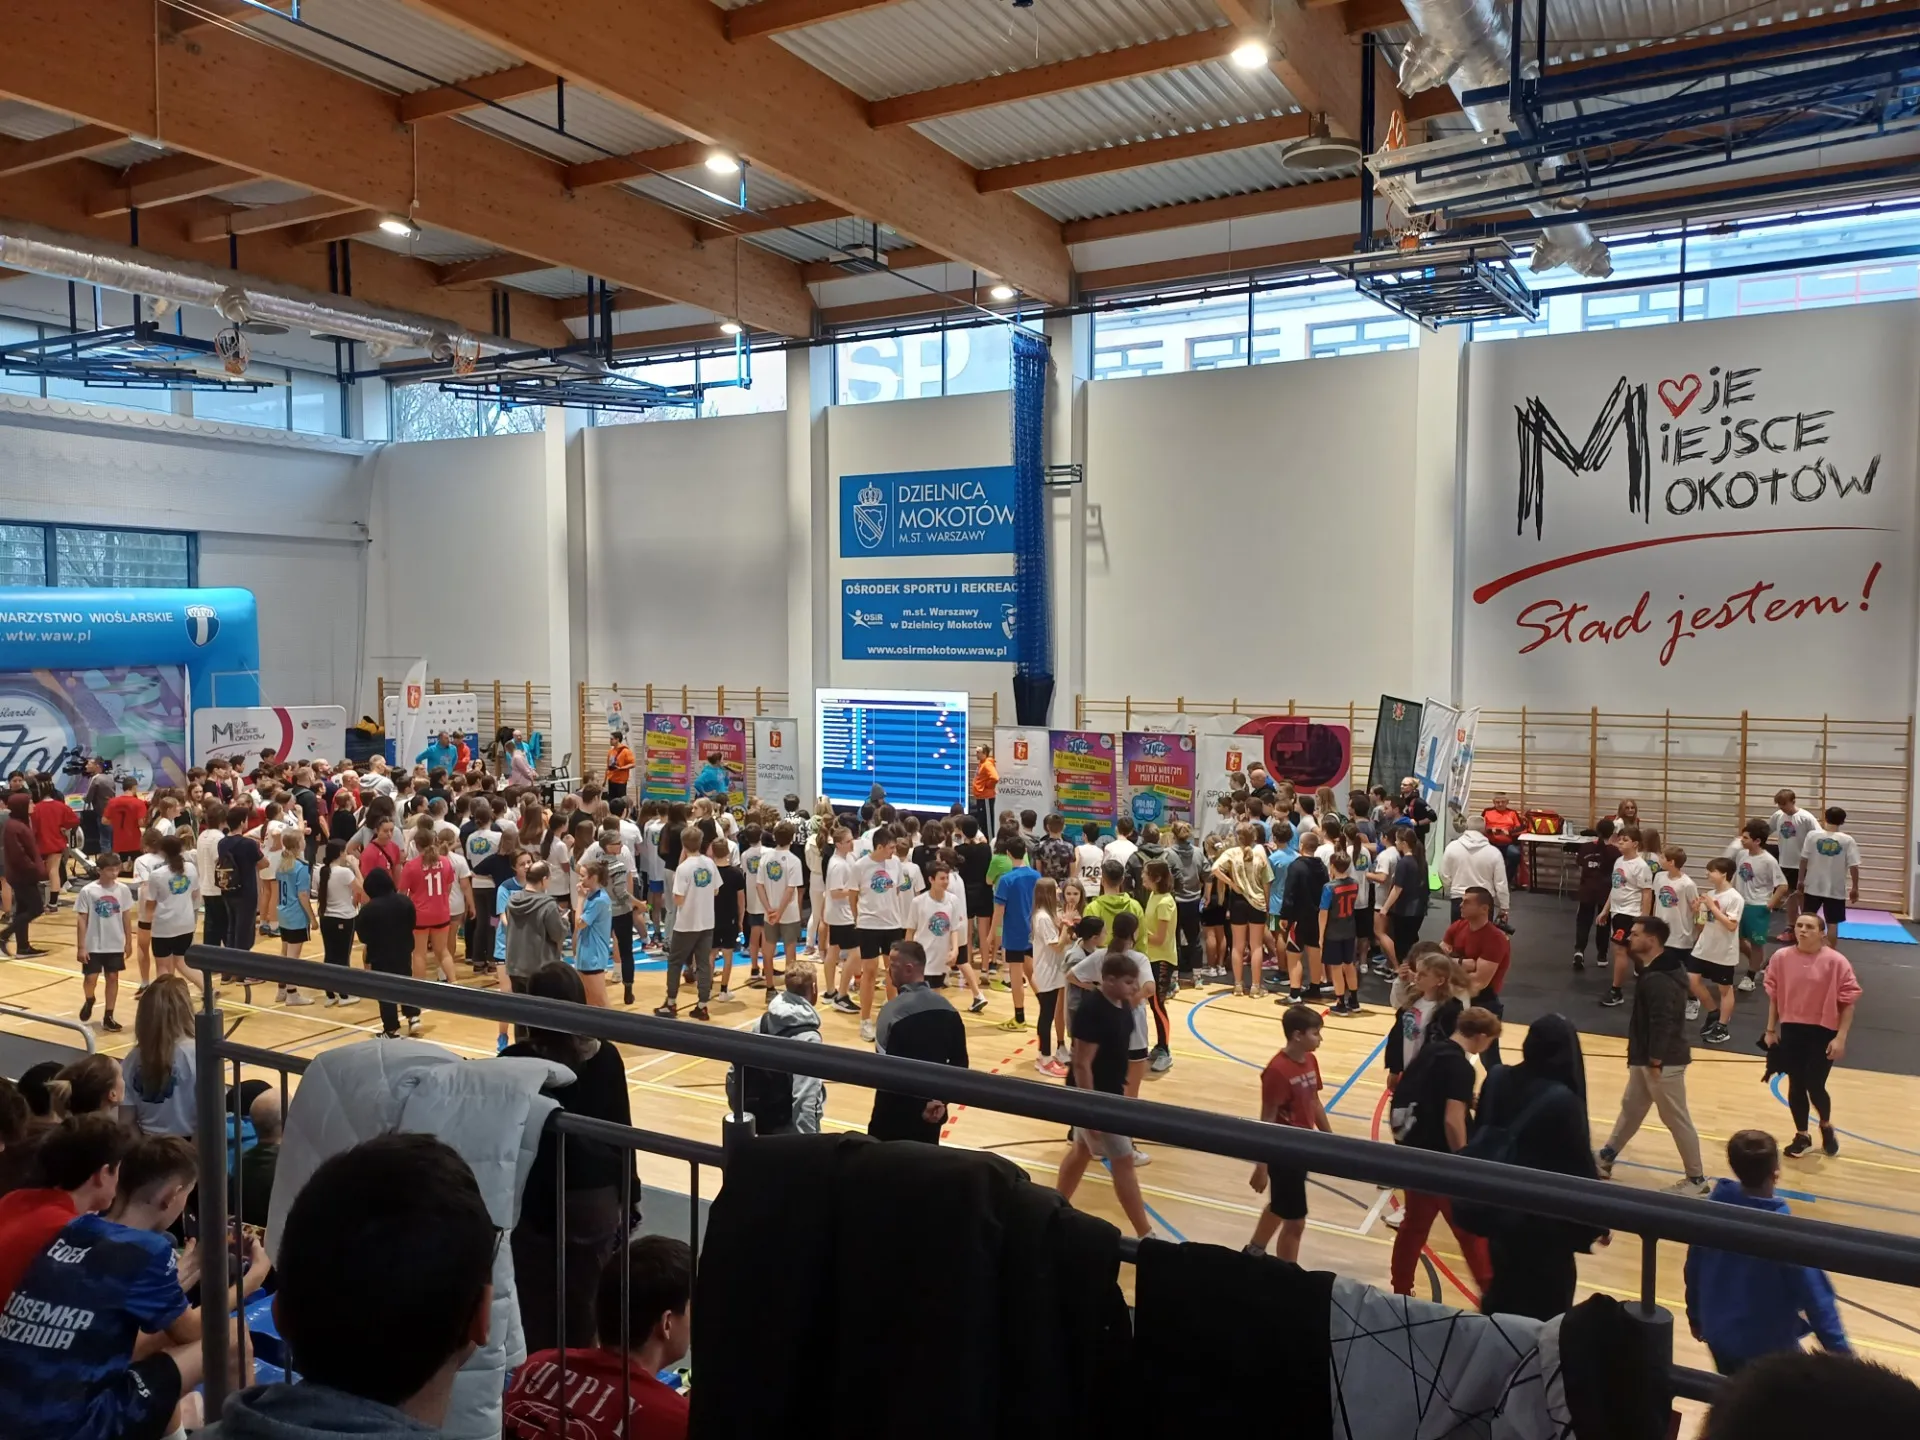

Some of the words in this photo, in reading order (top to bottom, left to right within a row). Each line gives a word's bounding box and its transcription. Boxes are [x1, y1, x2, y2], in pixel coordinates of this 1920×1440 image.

[899, 482, 986, 503] DZIELNICA
[899, 500, 1014, 529] MOKOTÓW
[927, 530, 985, 542] WARSZAWY
[846, 582, 900, 594] OŚRODEK
[903, 583, 951, 594] SPORTU
[89, 610, 173, 623] WIOŚLARSKIE
[903, 608, 926, 616] m.st.
[929, 608, 979, 618] Warszawy
[901, 620, 945, 631] Dzielnicy
[947, 620, 992, 629] Mokotów
[0, 630, 91, 643] .wtw.waw.pl
[867, 645, 1007, 657] www.osirmokotow.waw.pl
[758, 772, 794, 780] WARSZAWA
[998, 777, 1042, 786] SPORTOWA
[998, 788, 1043, 796] WARSZAWA
[1082, 866, 1100, 878] 126
[424, 871, 442, 897] 11
[278, 880, 287, 906] 19
[9, 1291, 95, 1330] ÓSEMKA
[0, 1313, 75, 1350] RSZAWA
